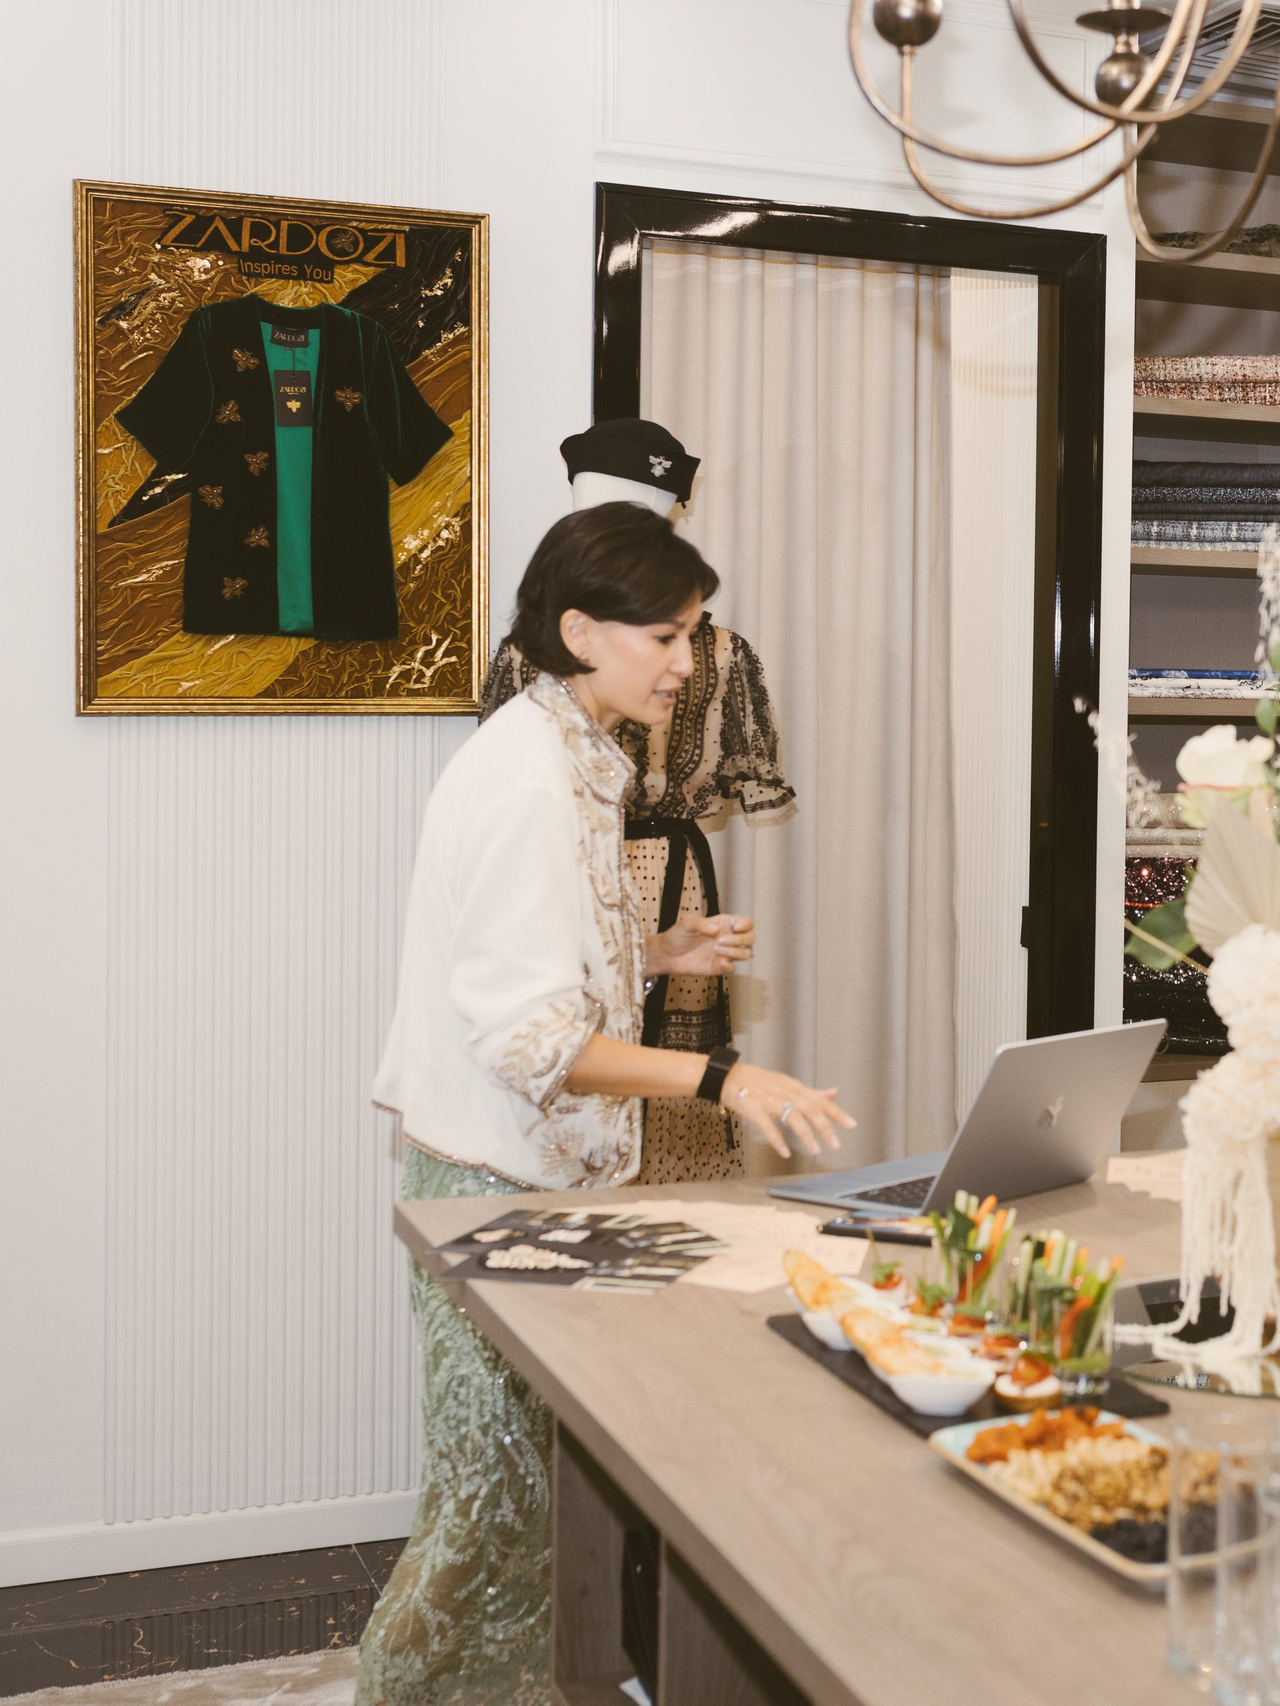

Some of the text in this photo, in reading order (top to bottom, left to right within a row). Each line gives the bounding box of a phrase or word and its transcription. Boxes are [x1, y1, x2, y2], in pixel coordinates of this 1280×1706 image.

[160, 210, 406, 268] ZARDOZI
[239, 258, 332, 281] Inspires You
[274, 331, 305, 342] ZARDOZI
